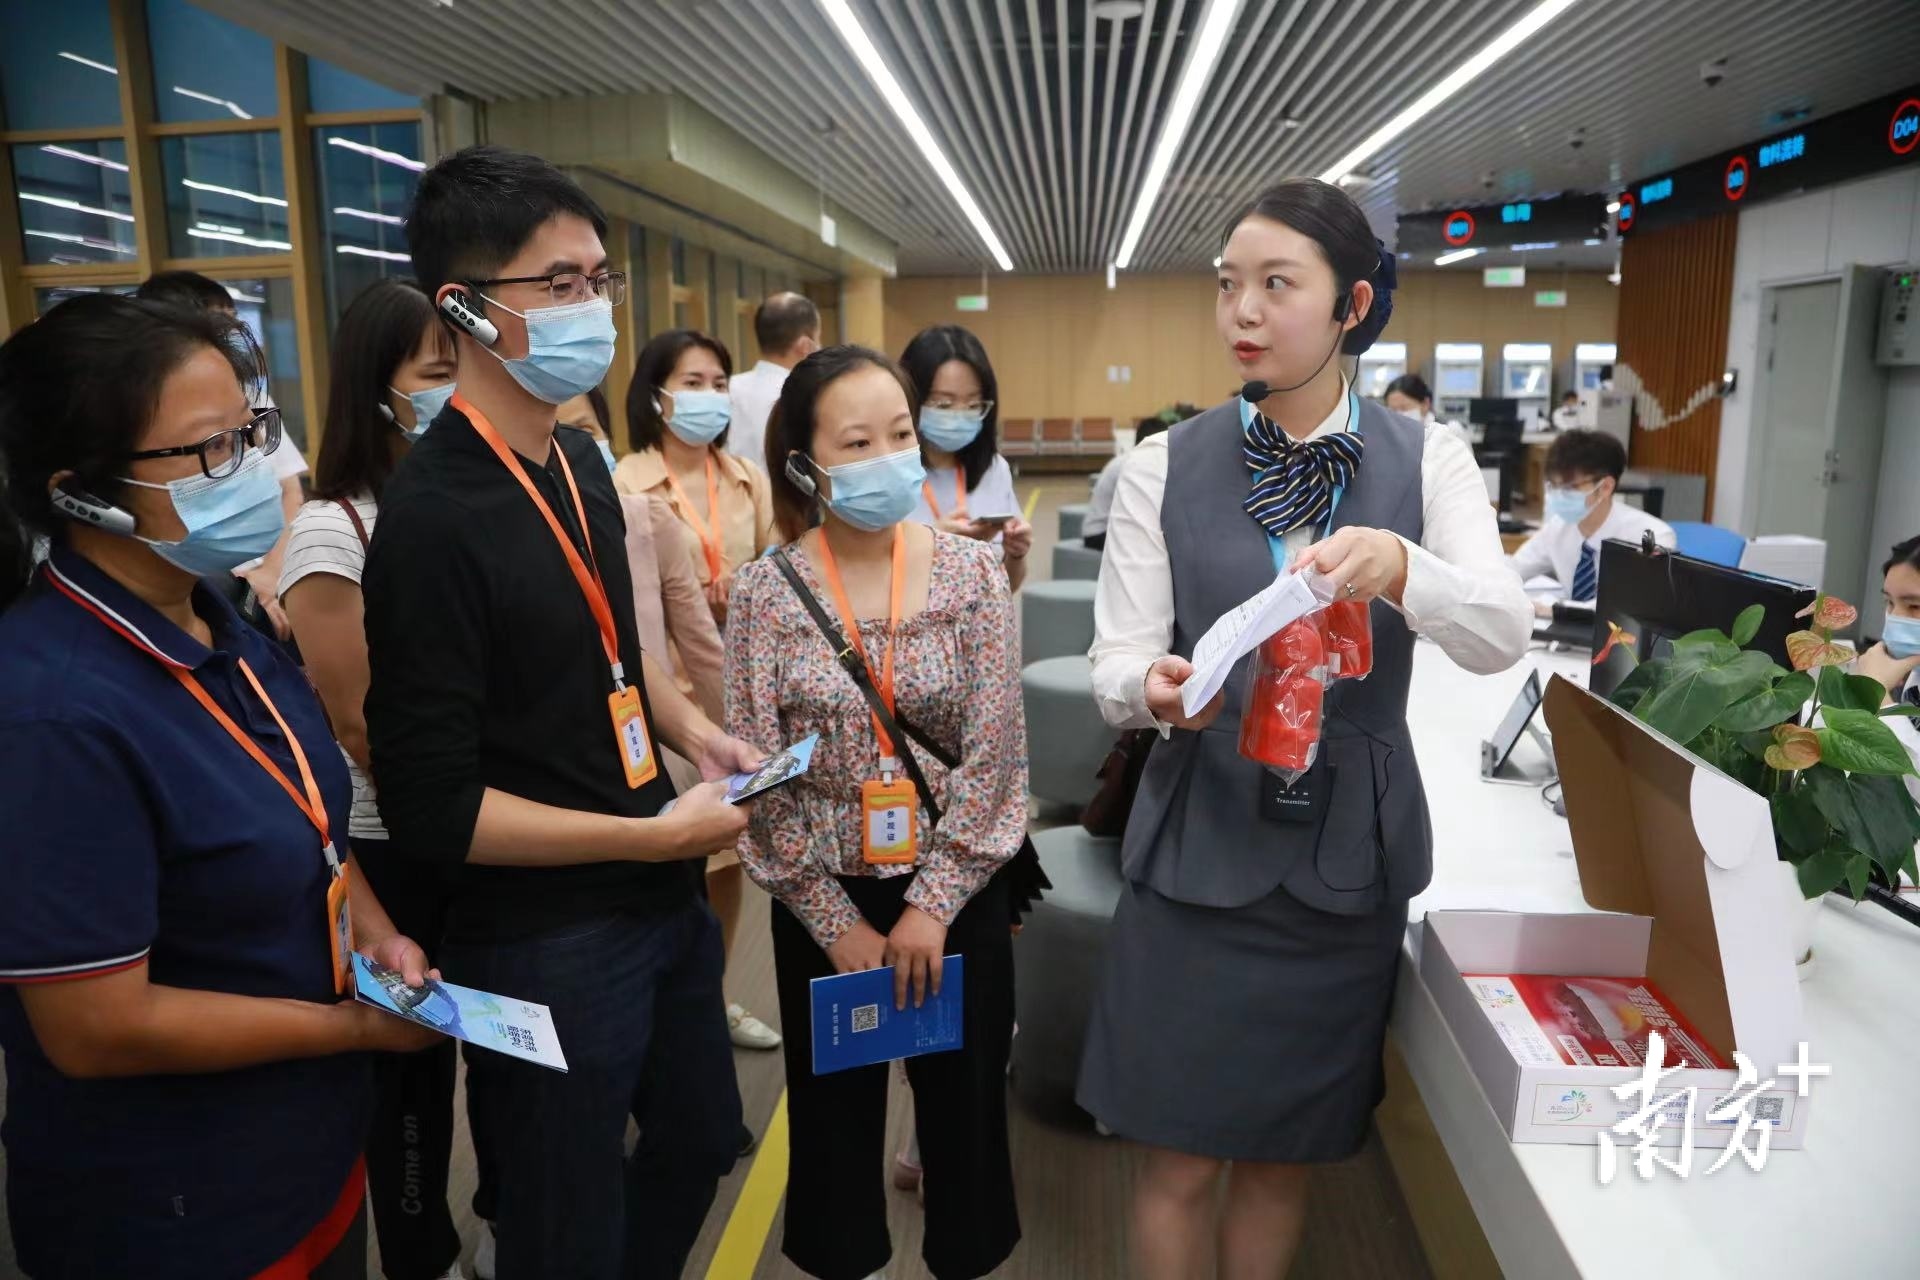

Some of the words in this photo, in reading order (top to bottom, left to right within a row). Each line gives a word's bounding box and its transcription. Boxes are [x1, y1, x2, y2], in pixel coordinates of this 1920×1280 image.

[1893, 116, 1919, 140] D04
[1276, 797, 1310, 806] Transmitter
[403, 1115, 418, 1143] on
[401, 1149, 422, 1214] Come
